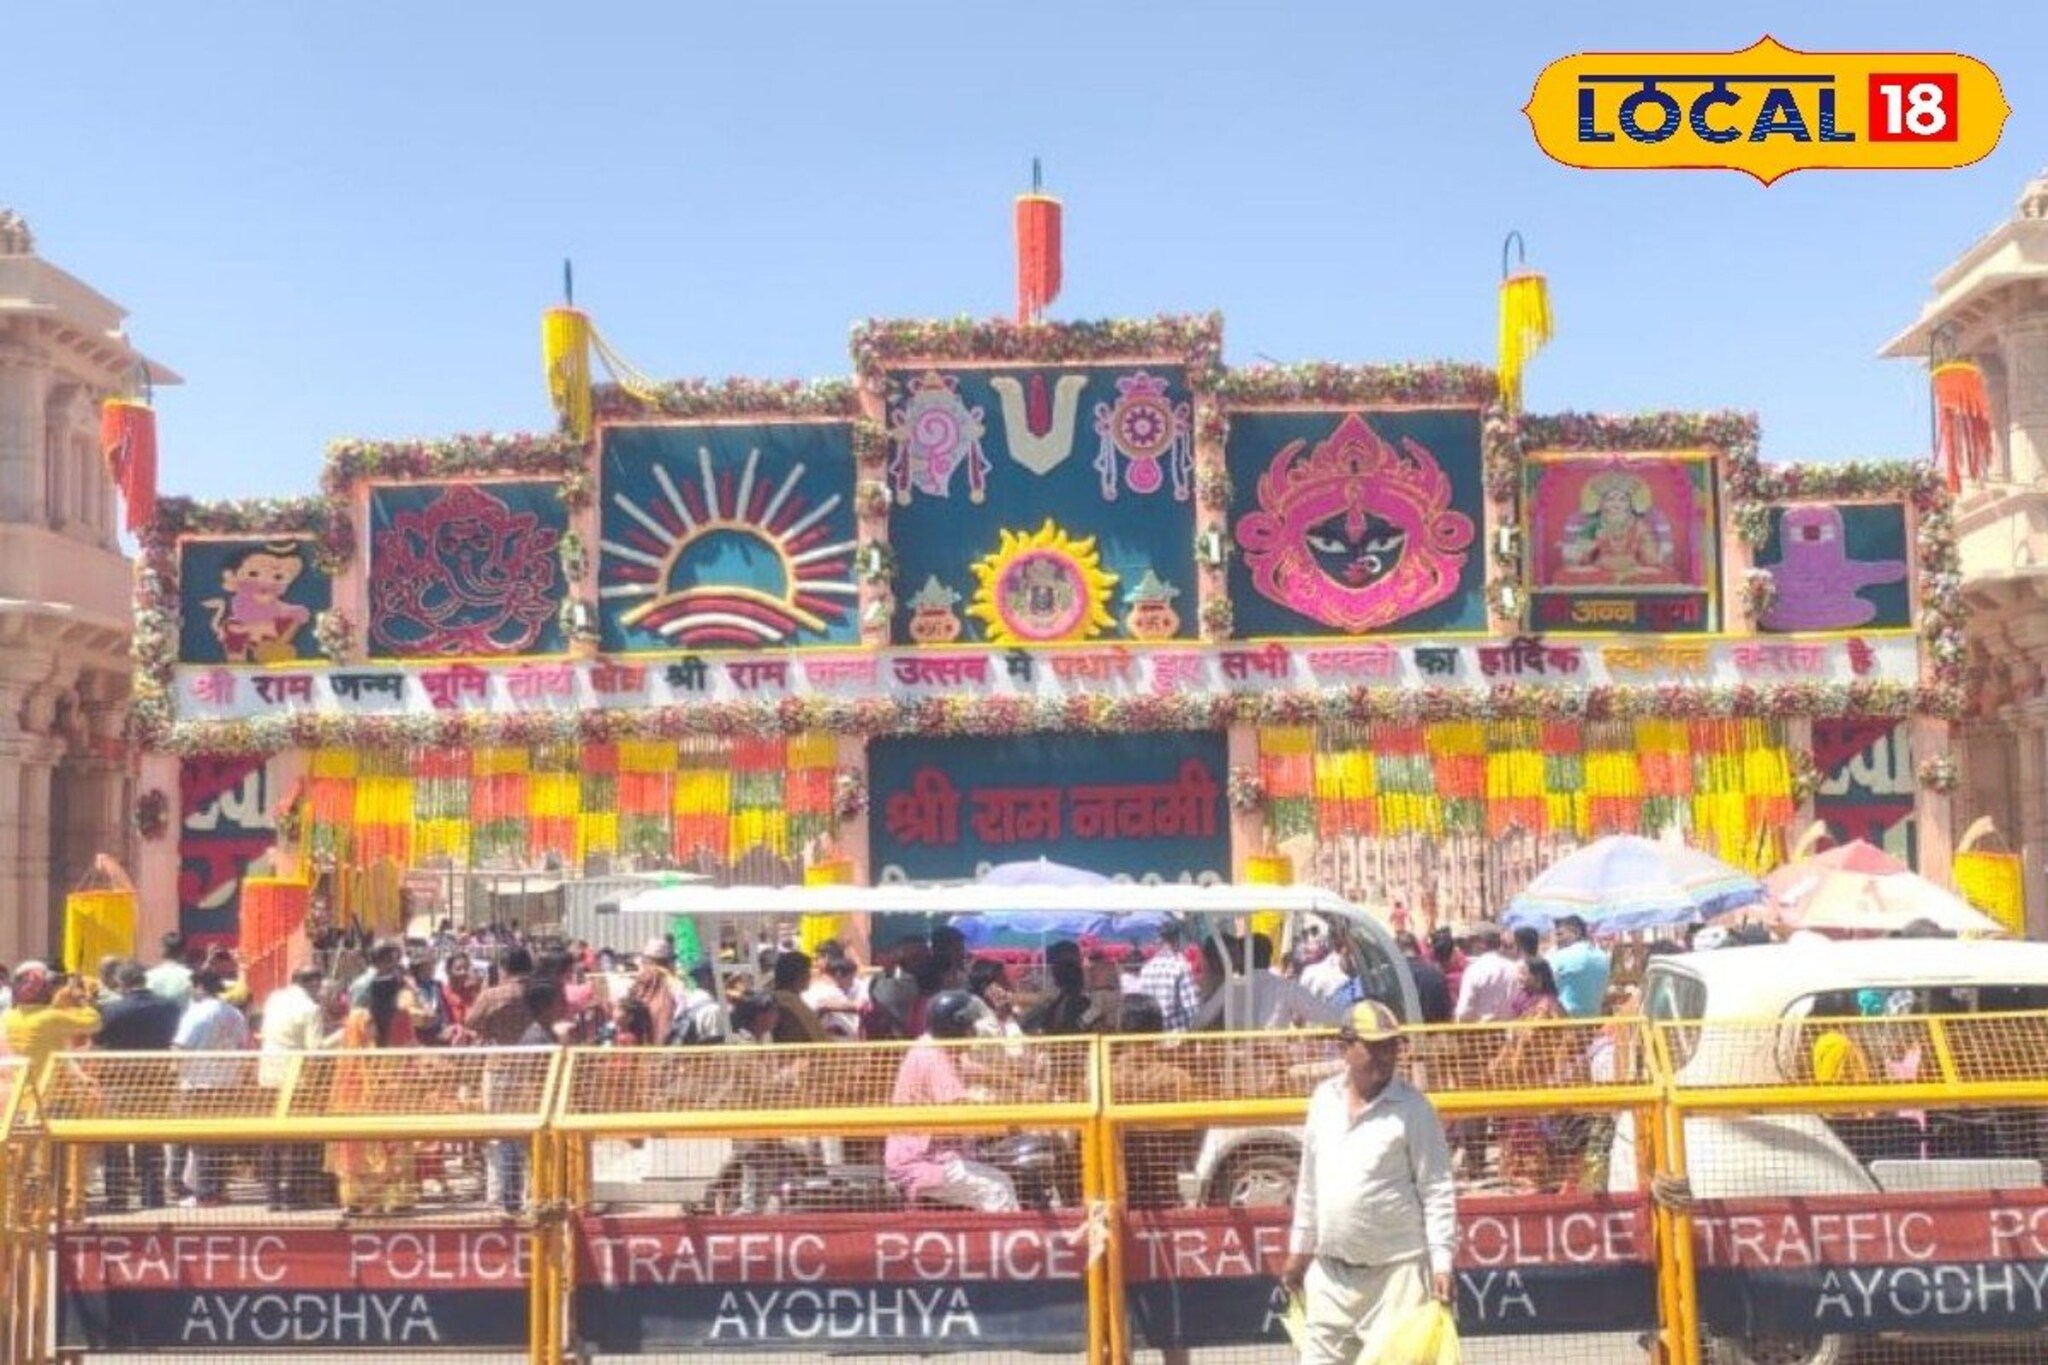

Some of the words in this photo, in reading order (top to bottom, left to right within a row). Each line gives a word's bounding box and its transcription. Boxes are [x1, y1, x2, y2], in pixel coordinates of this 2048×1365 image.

[252, 674, 312, 704] राम
[330, 672, 402, 702] जन्म
[419, 662, 490, 708] भूमि
[666, 655, 708, 690] श्री
[726, 660, 788, 689] राम
[892, 655, 988, 687] उत्सव
[1219, 641, 1291, 681] सभी
[1414, 647, 1460, 676] का
[1477, 635, 1583, 677] हार्दिक
[885, 764, 960, 846] श्री
[970, 787, 1062, 843] राम
[1067, 756, 1217, 840] नवमी
[66, 1236, 288, 1282] TRAFFIC
[350, 1233, 535, 1281] POLICE
[593, 1232, 828, 1288] TRAFFIC
[874, 1230, 1082, 1281] POLICE
[1135, 1226, 1283, 1277] TRAF
[1692, 1212, 1937, 1265] TRAFFIC
[710, 1288, 980, 1338] AYODHYA
[1815, 1264, 2048, 1318] AYODHY
[182, 1296, 440, 1341] AYODHYA
